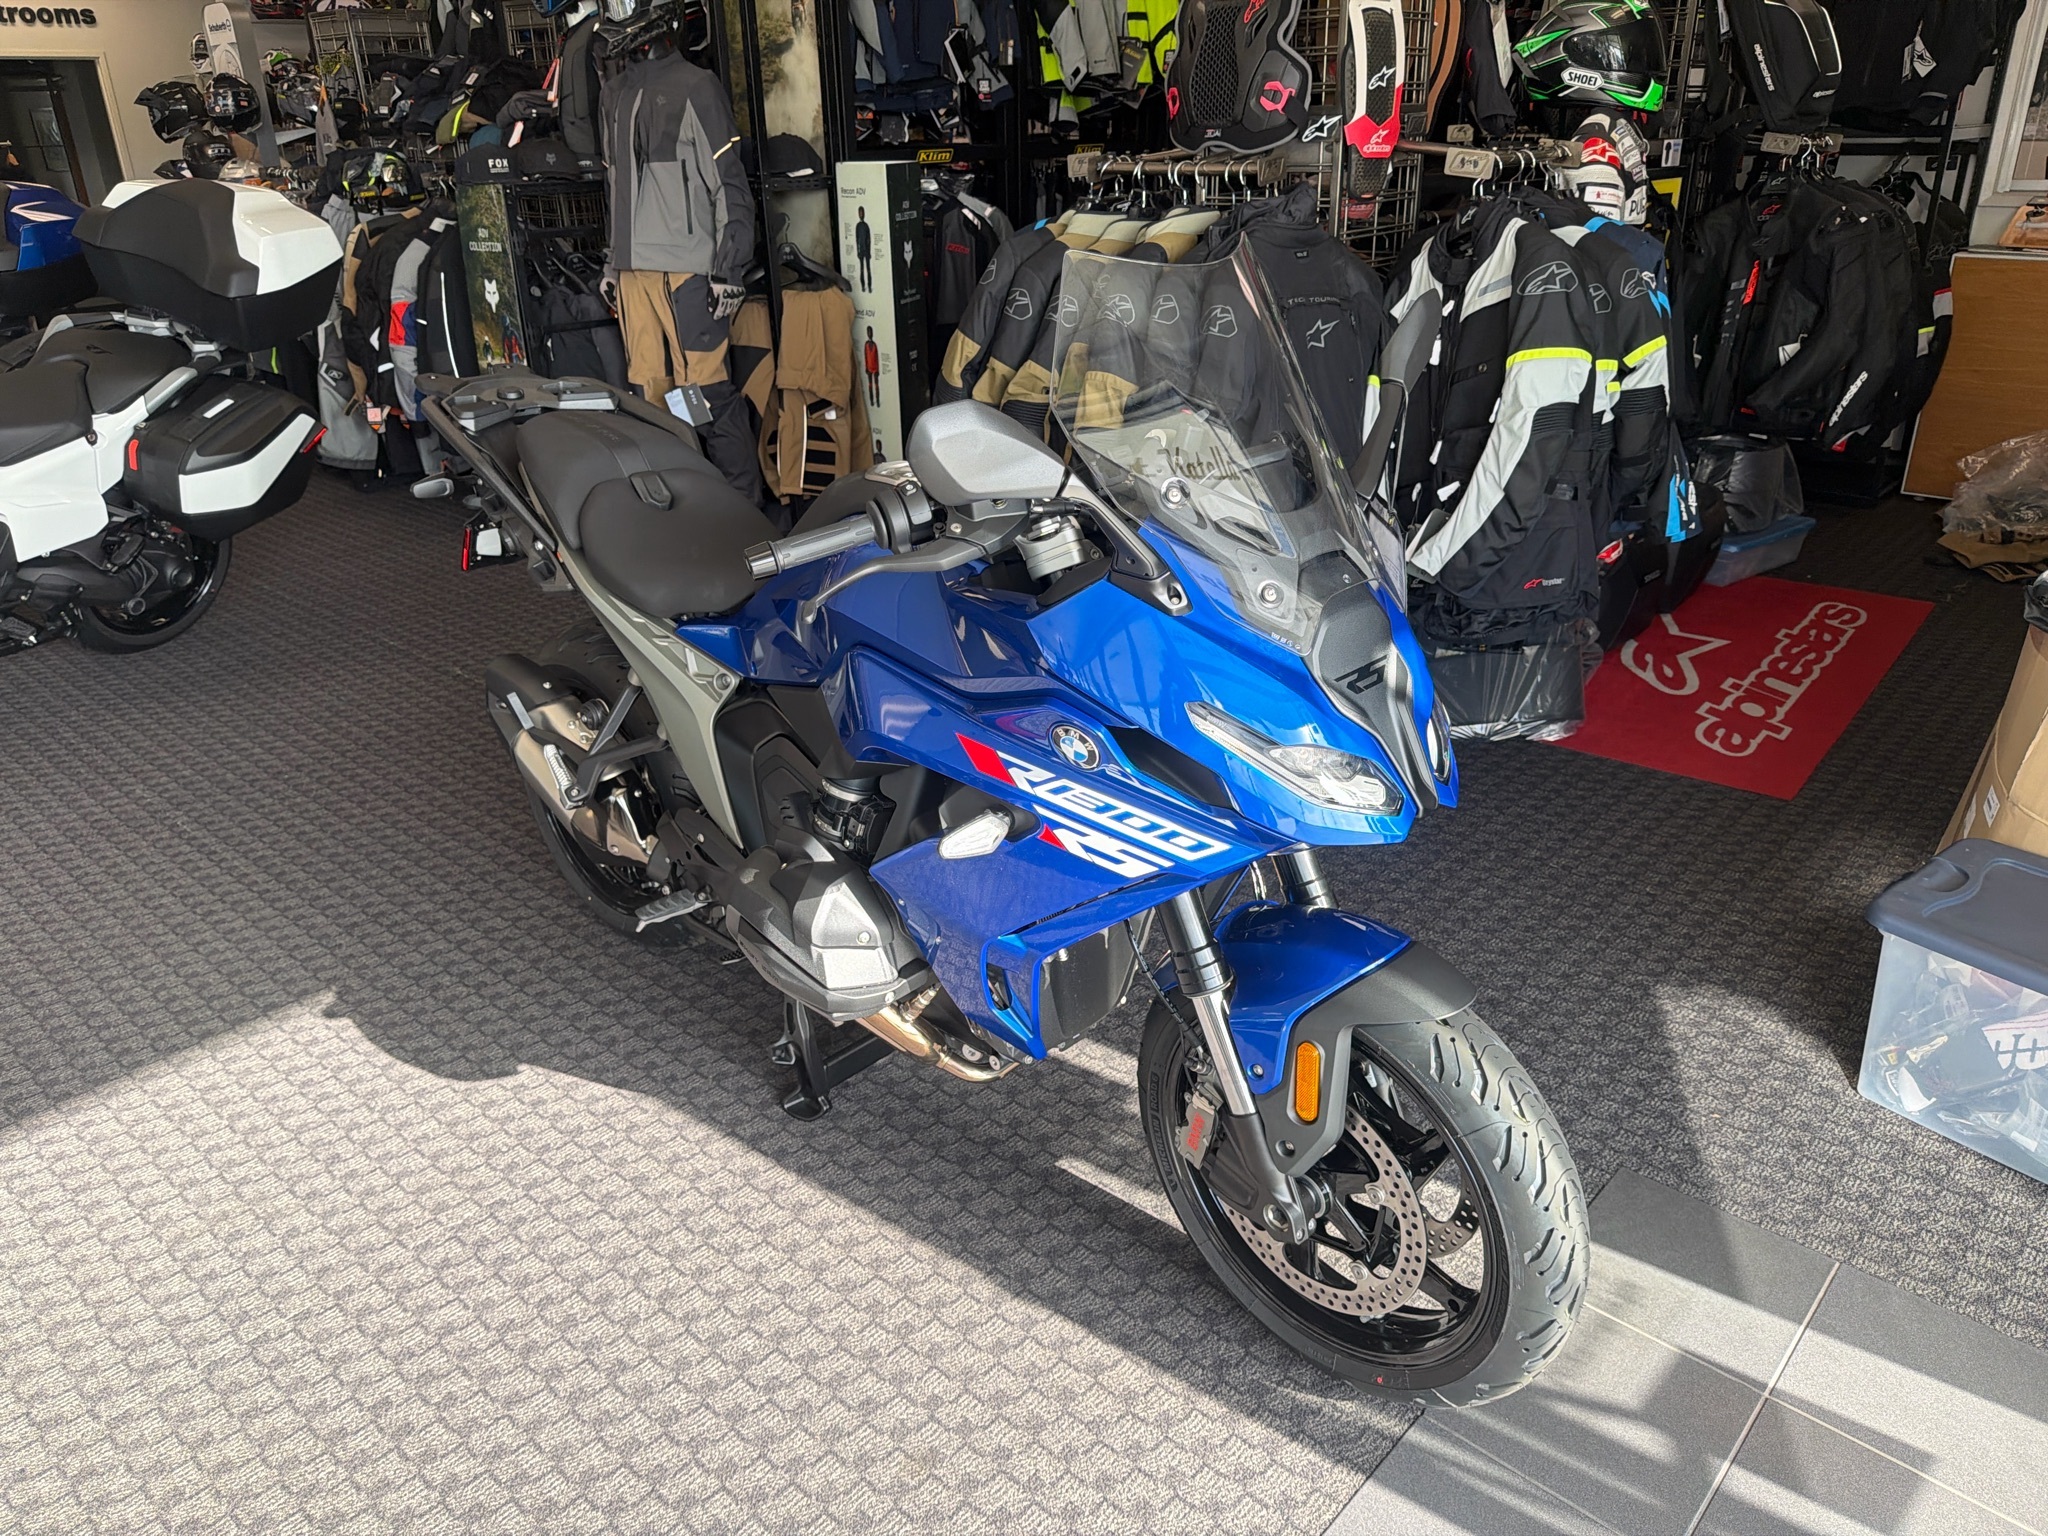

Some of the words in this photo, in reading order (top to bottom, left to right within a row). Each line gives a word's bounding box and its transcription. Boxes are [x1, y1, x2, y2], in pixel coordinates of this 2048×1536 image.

[1567, 71, 1598, 86] SHOEI
[1753, 43, 1775, 91] alpinestars
[488, 158, 509, 168] FOX
[918, 151, 951, 162] Klim
[468, 241, 502, 252] COLLECTION
[1695, 601, 1868, 757] alpinestars
[1033, 803, 1176, 879] RS
[1150, 1082, 1159, 1110] ROAD
[1151, 1117, 1174, 1176] MICHELIN
[1186, 1111, 1206, 1152] BMW
